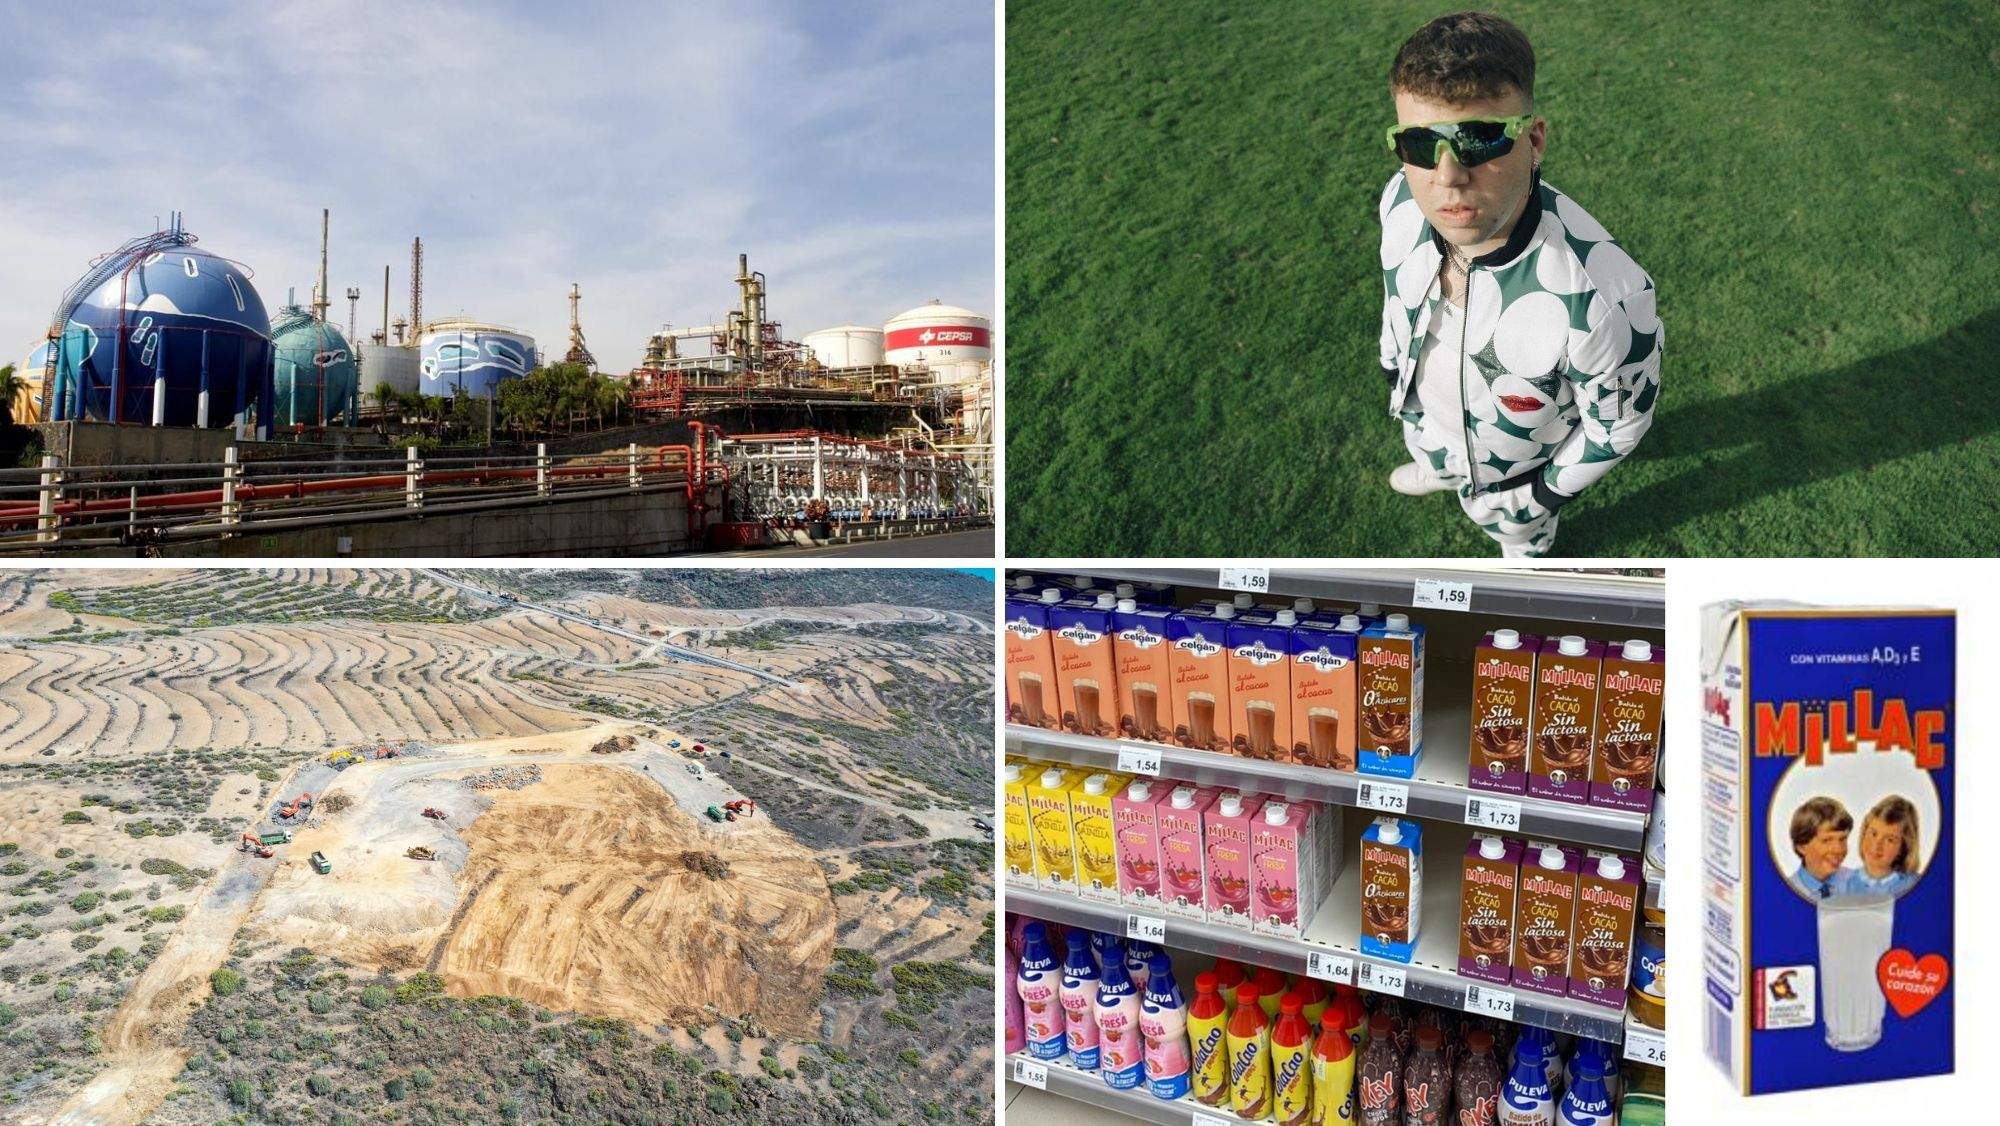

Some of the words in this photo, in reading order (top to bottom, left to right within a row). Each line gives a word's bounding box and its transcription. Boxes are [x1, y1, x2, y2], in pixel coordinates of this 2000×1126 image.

[937, 331, 973, 341] CEPSA
[1241, 576, 1265, 587] 1,59
[1438, 589, 1465, 602] 1,59
[1791, 654, 1814, 664] CON
[1815, 653, 1869, 664] VITAMINAS
[1910, 646, 1920, 662] E
[1372, 680, 1398, 692] CACAO
[1486, 692, 1516, 706] CACAO
[1488, 705, 1512, 718] Sin
[1550, 700, 1580, 714] CACAO
[1614, 707, 1646, 720] CACAO
[1480, 716, 1523, 728] lactosa
[1550, 714, 1576, 726] Sin
[1542, 726, 1588, 736] lactosa
[1615, 720, 1641, 733] Sin
[1606, 732, 1652, 744] lactosa
[1137, 760, 1157, 771] 1,54
[1378, 796, 1402, 808] 1,73
[1490, 812, 1515, 825] 1,73
[1373, 875, 1398, 886] CACAO
[1474, 896, 1500, 908] CACAO
[1476, 907, 1497, 918] Sin
[1532, 906, 1558, 918] CACAO
[1468, 917, 1506, 926] lactosa
[1532, 917, 1555, 929] Sin
[1588, 917, 1617, 930] CACAO
[1144, 926, 1162, 936] 1,64
[1524, 928, 1565, 937] lactosa
[1590, 928, 1613, 939] Sin
[1582, 938, 1624, 949] lactosa
[1326, 964, 1348, 977] 1,64
[1888, 962, 1922, 979] Cuide
[1379, 975, 1401, 988] 1,73
[1487, 998, 1511, 1011] 1,73
[1509, 1076, 1548, 1096] PULEVA
[1567, 1091, 1607, 1112] PULEVA
[1509, 1111, 1532, 1121] Batido
